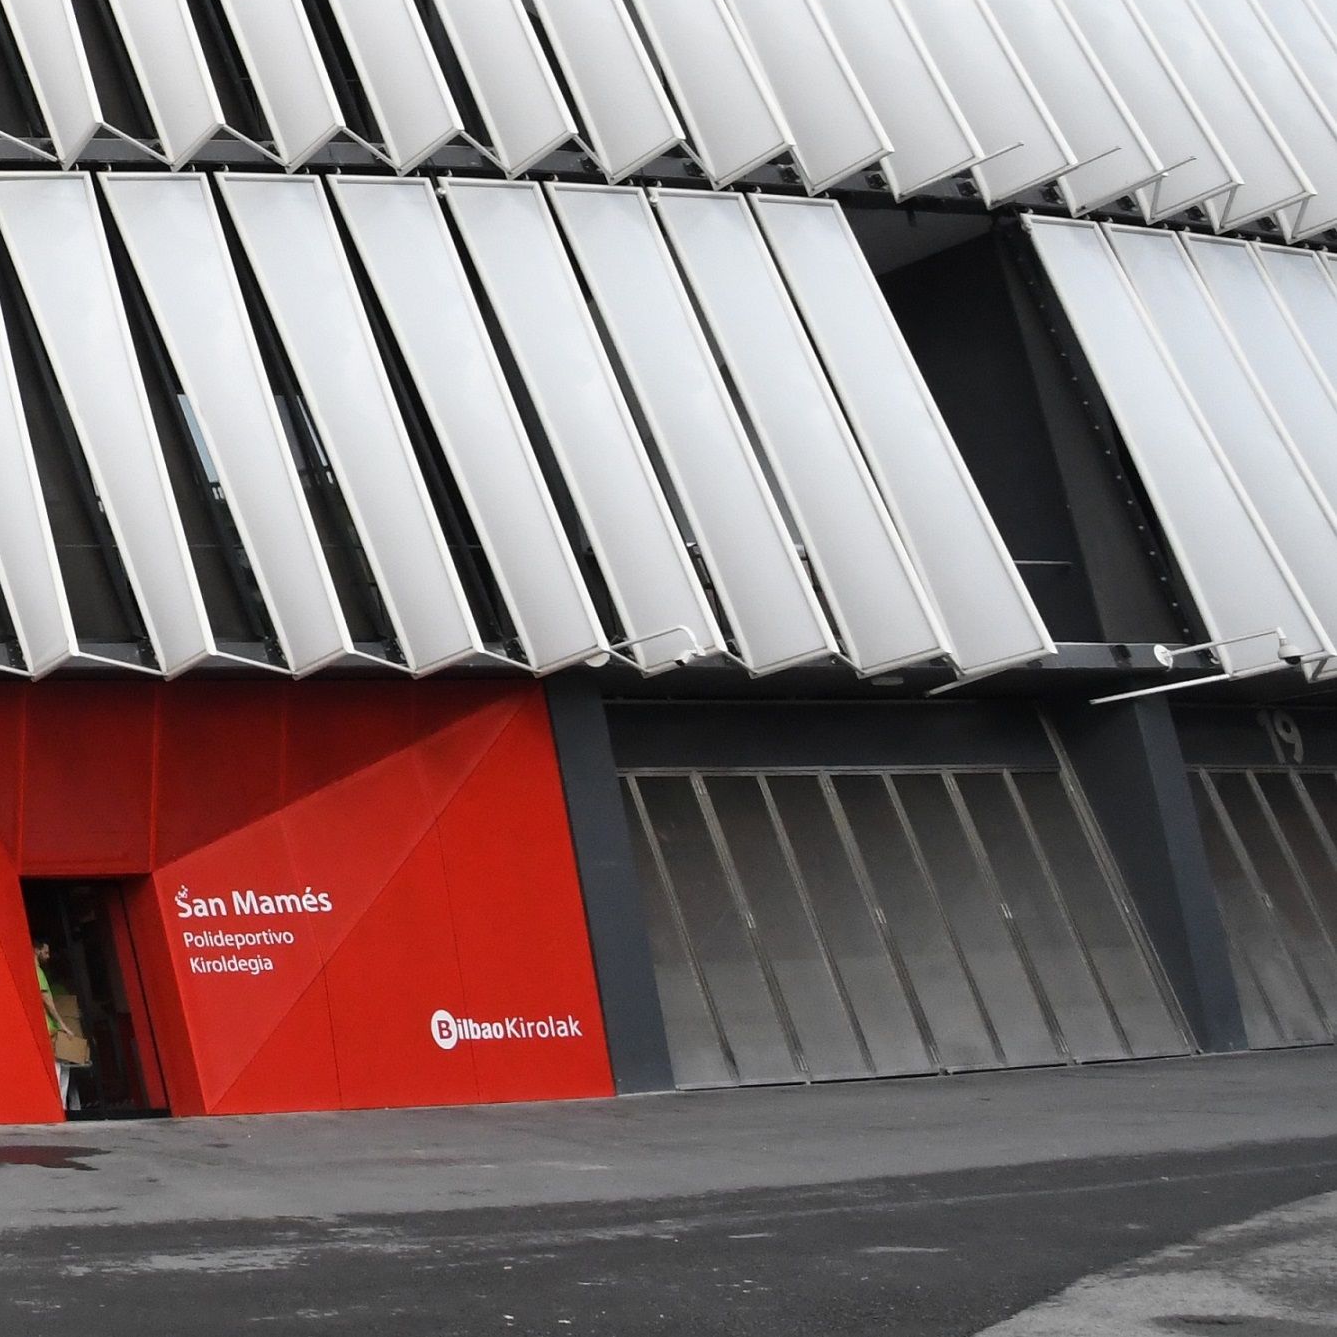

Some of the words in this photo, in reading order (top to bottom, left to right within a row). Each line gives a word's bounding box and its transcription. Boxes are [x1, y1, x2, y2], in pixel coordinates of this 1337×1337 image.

[1256, 708, 1304, 765] 19
[175, 886, 228, 918] San
[231, 887, 333, 915] Mamés
[183, 929, 295, 950] Polideportivo
[190, 955, 274, 975] Kiroldegia
